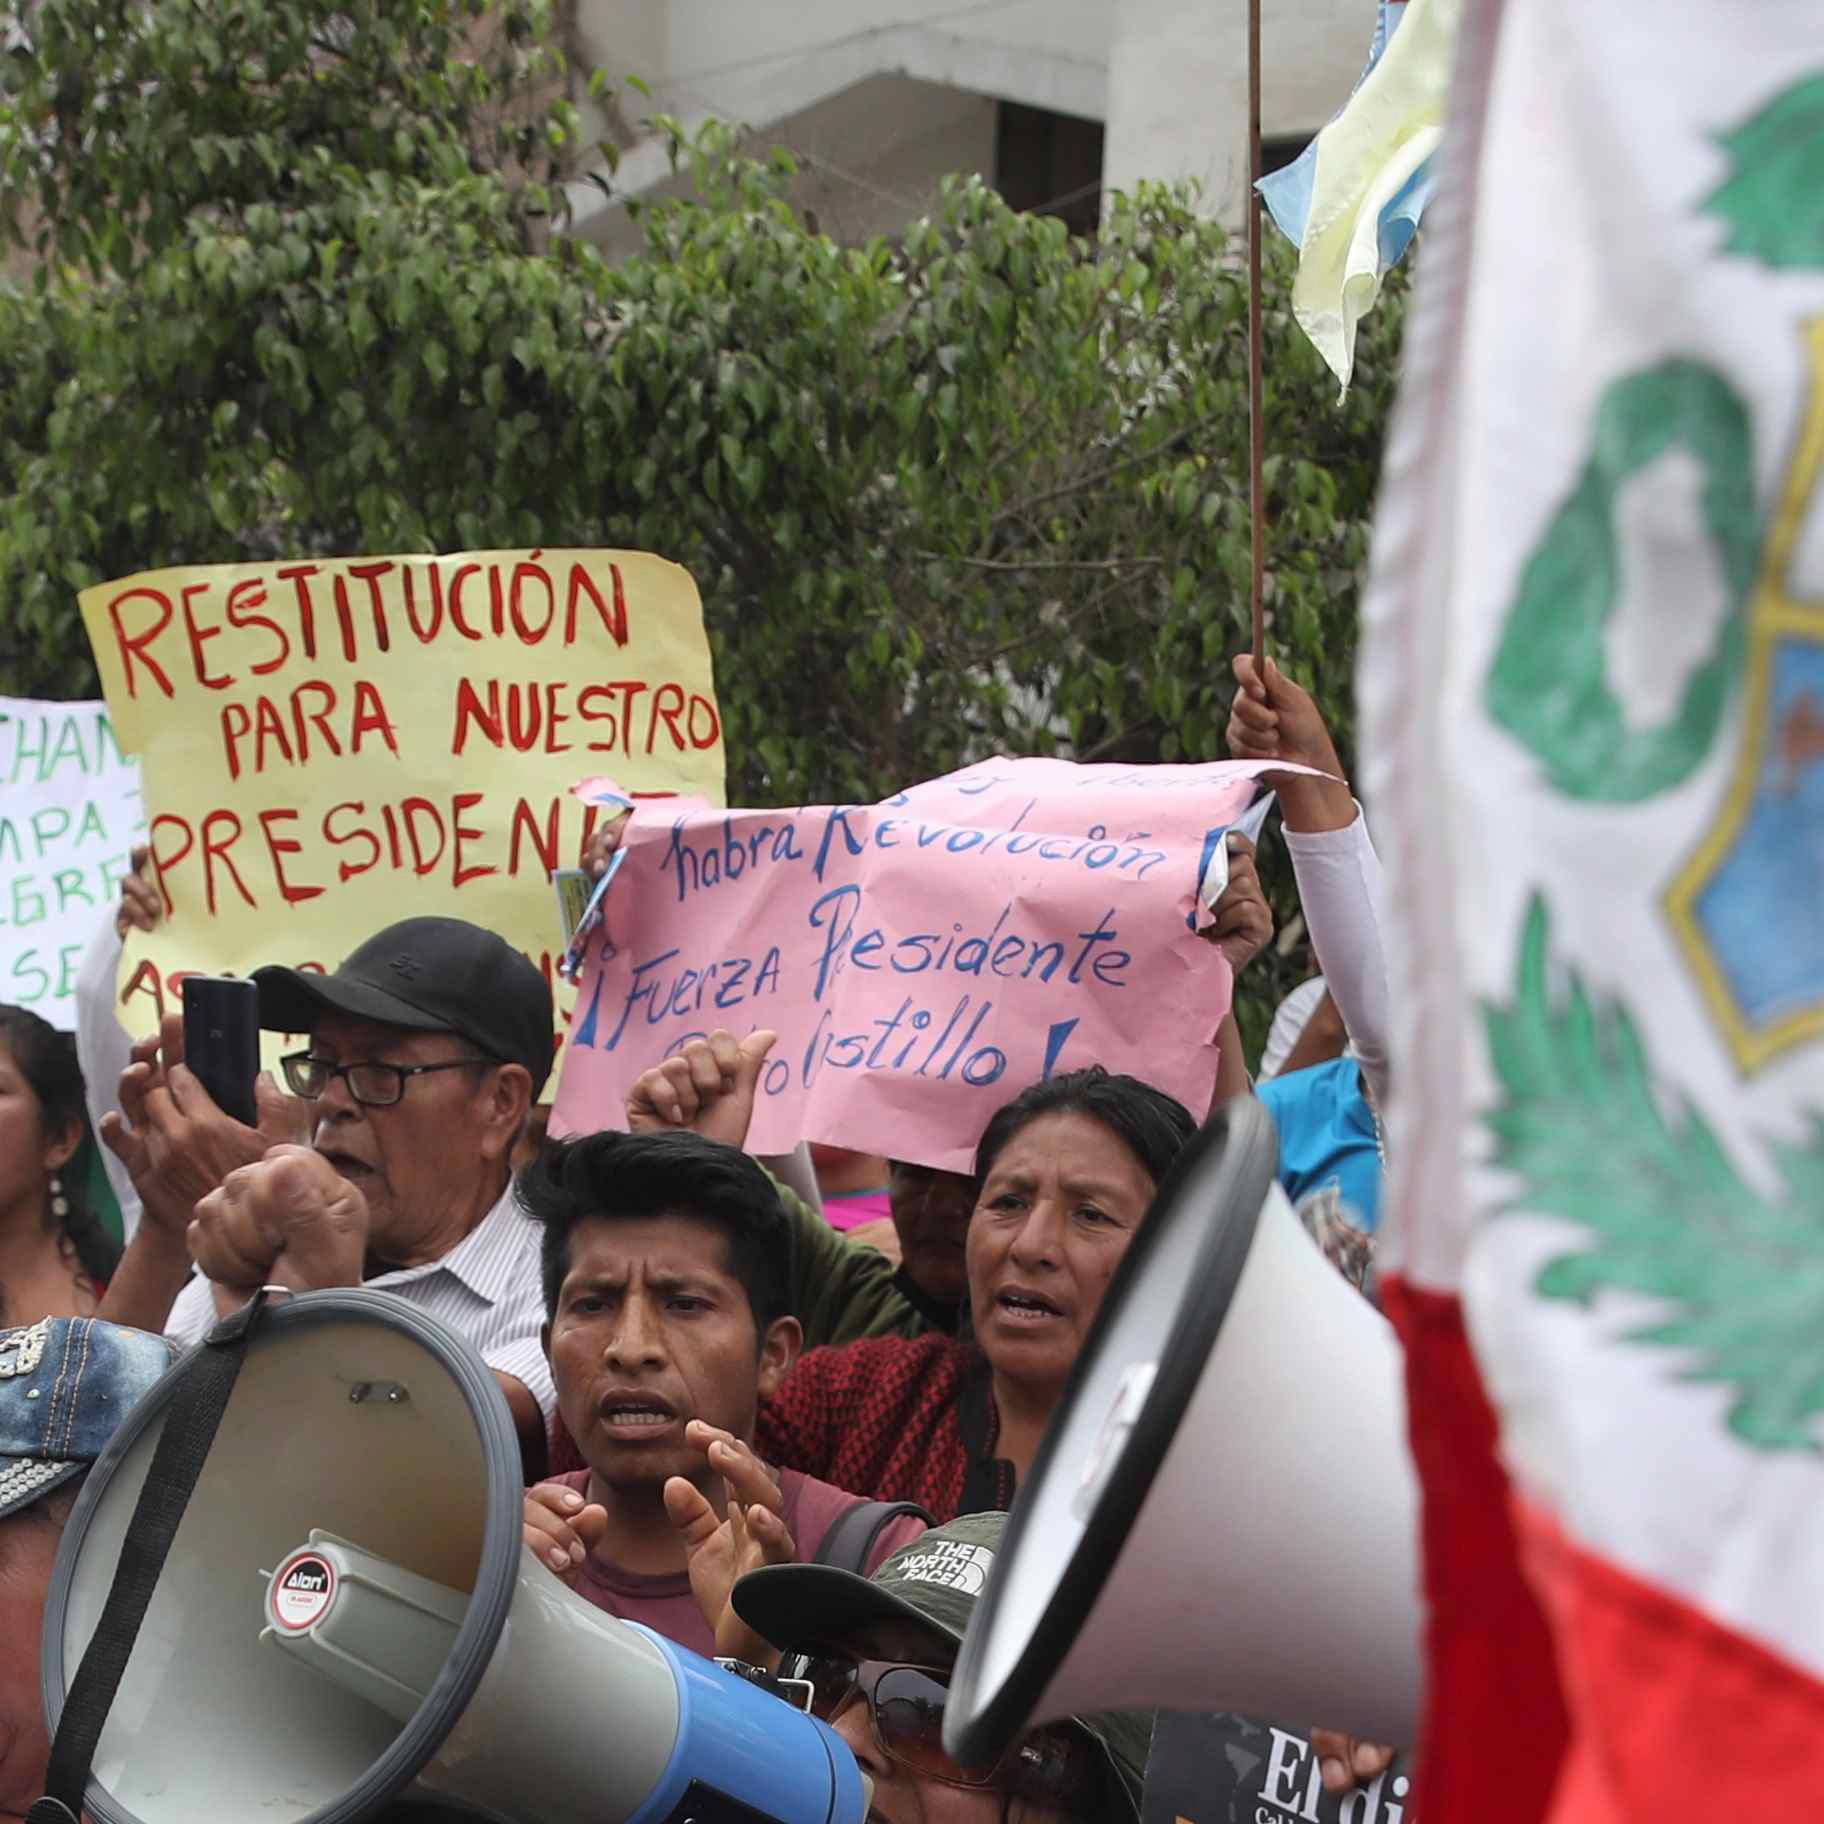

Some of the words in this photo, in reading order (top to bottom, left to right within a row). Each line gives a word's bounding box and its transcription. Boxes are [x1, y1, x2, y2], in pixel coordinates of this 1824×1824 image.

[108, 549, 628, 699] RESTITUCIÓN
[222, 679, 401, 781] PARA
[451, 678, 721, 758] NUESTRO
[897, 1555, 964, 1574] NORTH
[902, 1568, 954, 1585] FACE
[935, 1540, 976, 1558] THE
[1257, 1726, 1320, 1824] El
